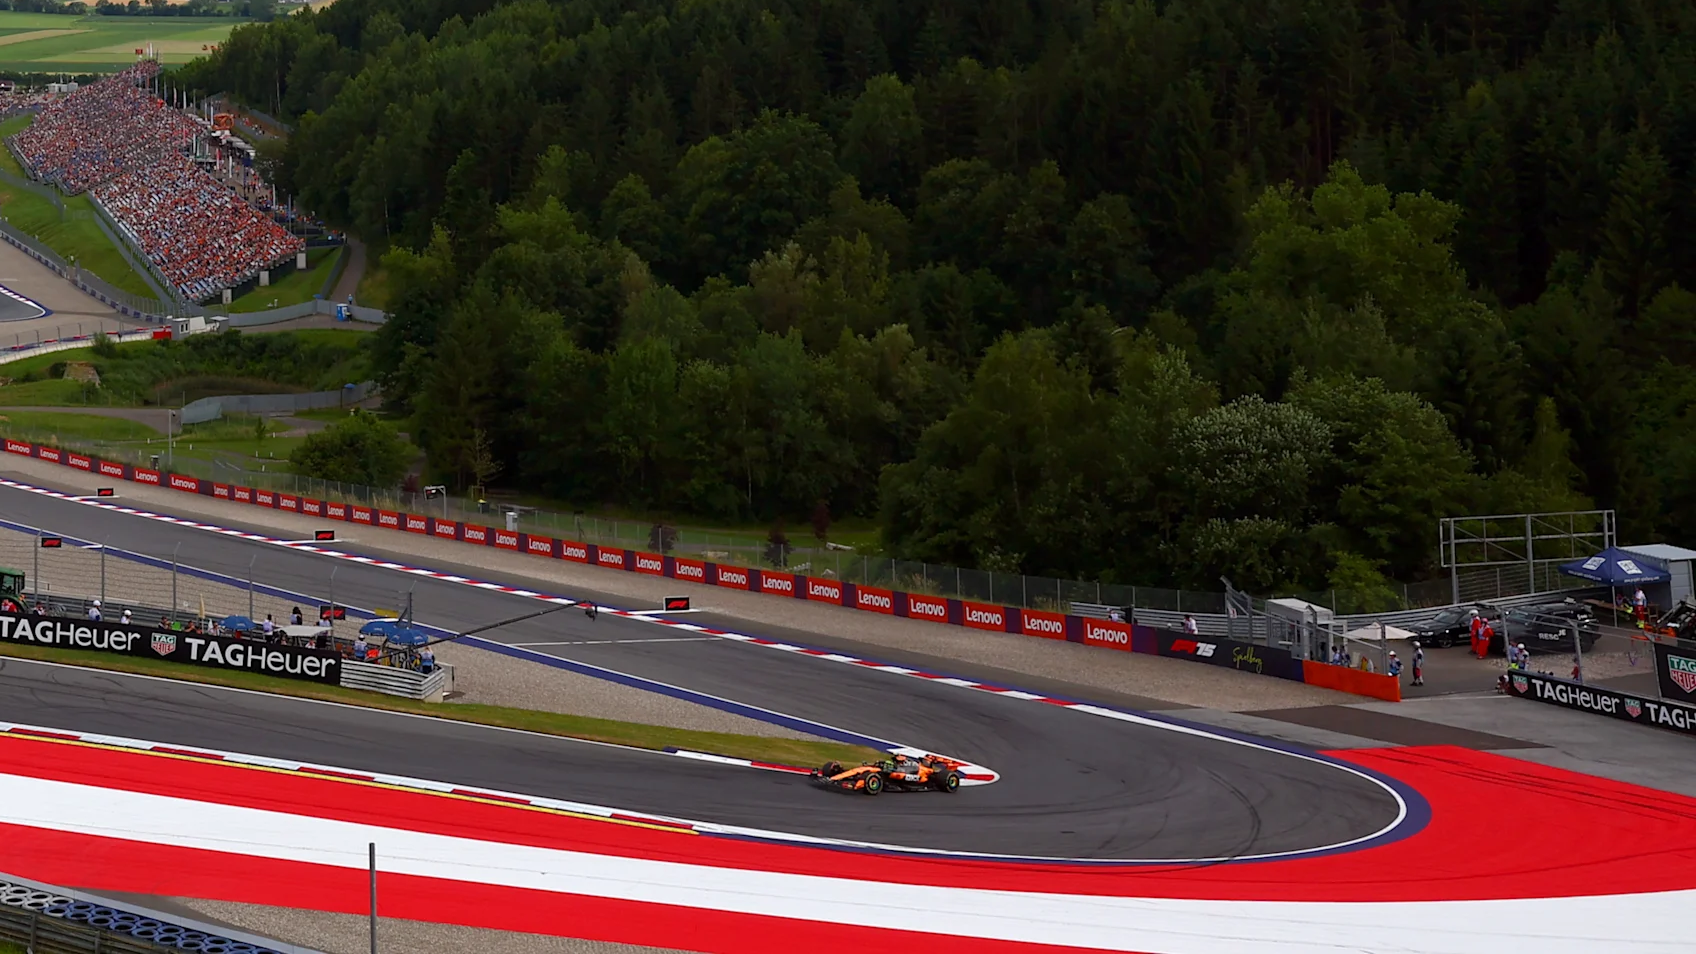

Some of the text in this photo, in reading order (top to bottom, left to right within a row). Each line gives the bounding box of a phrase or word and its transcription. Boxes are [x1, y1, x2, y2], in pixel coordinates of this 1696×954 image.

[8, 440, 30, 453] Lenovo
[40, 448, 58, 460] Lenovo
[69, 456, 89, 467] Lenovo
[101, 464, 121, 475] Lenovo
[136, 470, 157, 482] Lenovo
[172, 477, 196, 489] Lenovo
[257, 493, 272, 504] Lenovo
[280, 497, 296, 508] Lenovo
[304, 502, 319, 512] Lenovo
[327, 505, 344, 516] Lenovo
[353, 509, 370, 520] Lenovo
[379, 514, 397, 525] Lenovo
[407, 518, 425, 529] Lenovo
[436, 522, 454, 535] Lenovo
[465, 527, 484, 540] Lenovo
[496, 533, 516, 546] Lenovo
[529, 538, 550, 551] Lenovo
[563, 544, 586, 558] Lenovo
[599, 550, 622, 564] Lenovo
[637, 556, 661, 570] Lenovo
[676, 562, 702, 577] Lenovo
[719, 568, 746, 584] Lenovo
[763, 575, 791, 591] Lenovo
[809, 582, 839, 598] Lenovo
[858, 590, 890, 608] Lenovo
[910, 598, 944, 616] Lenovo
[966, 607, 1002, 625] Lenovo
[1024, 615, 1062, 633] Lenovo
[153, 634, 174, 643] TAG
[1087, 623, 1127, 644] Lenovo
[152, 643, 175, 654] HEUER
[185, 637, 336, 677] TAGHeuer
[1232, 646, 1263, 674] Spielberg
[1513, 675, 1528, 684] TAG
[1532, 679, 1620, 713] TAGHeuer
[1625, 698, 1641, 708] TAG
